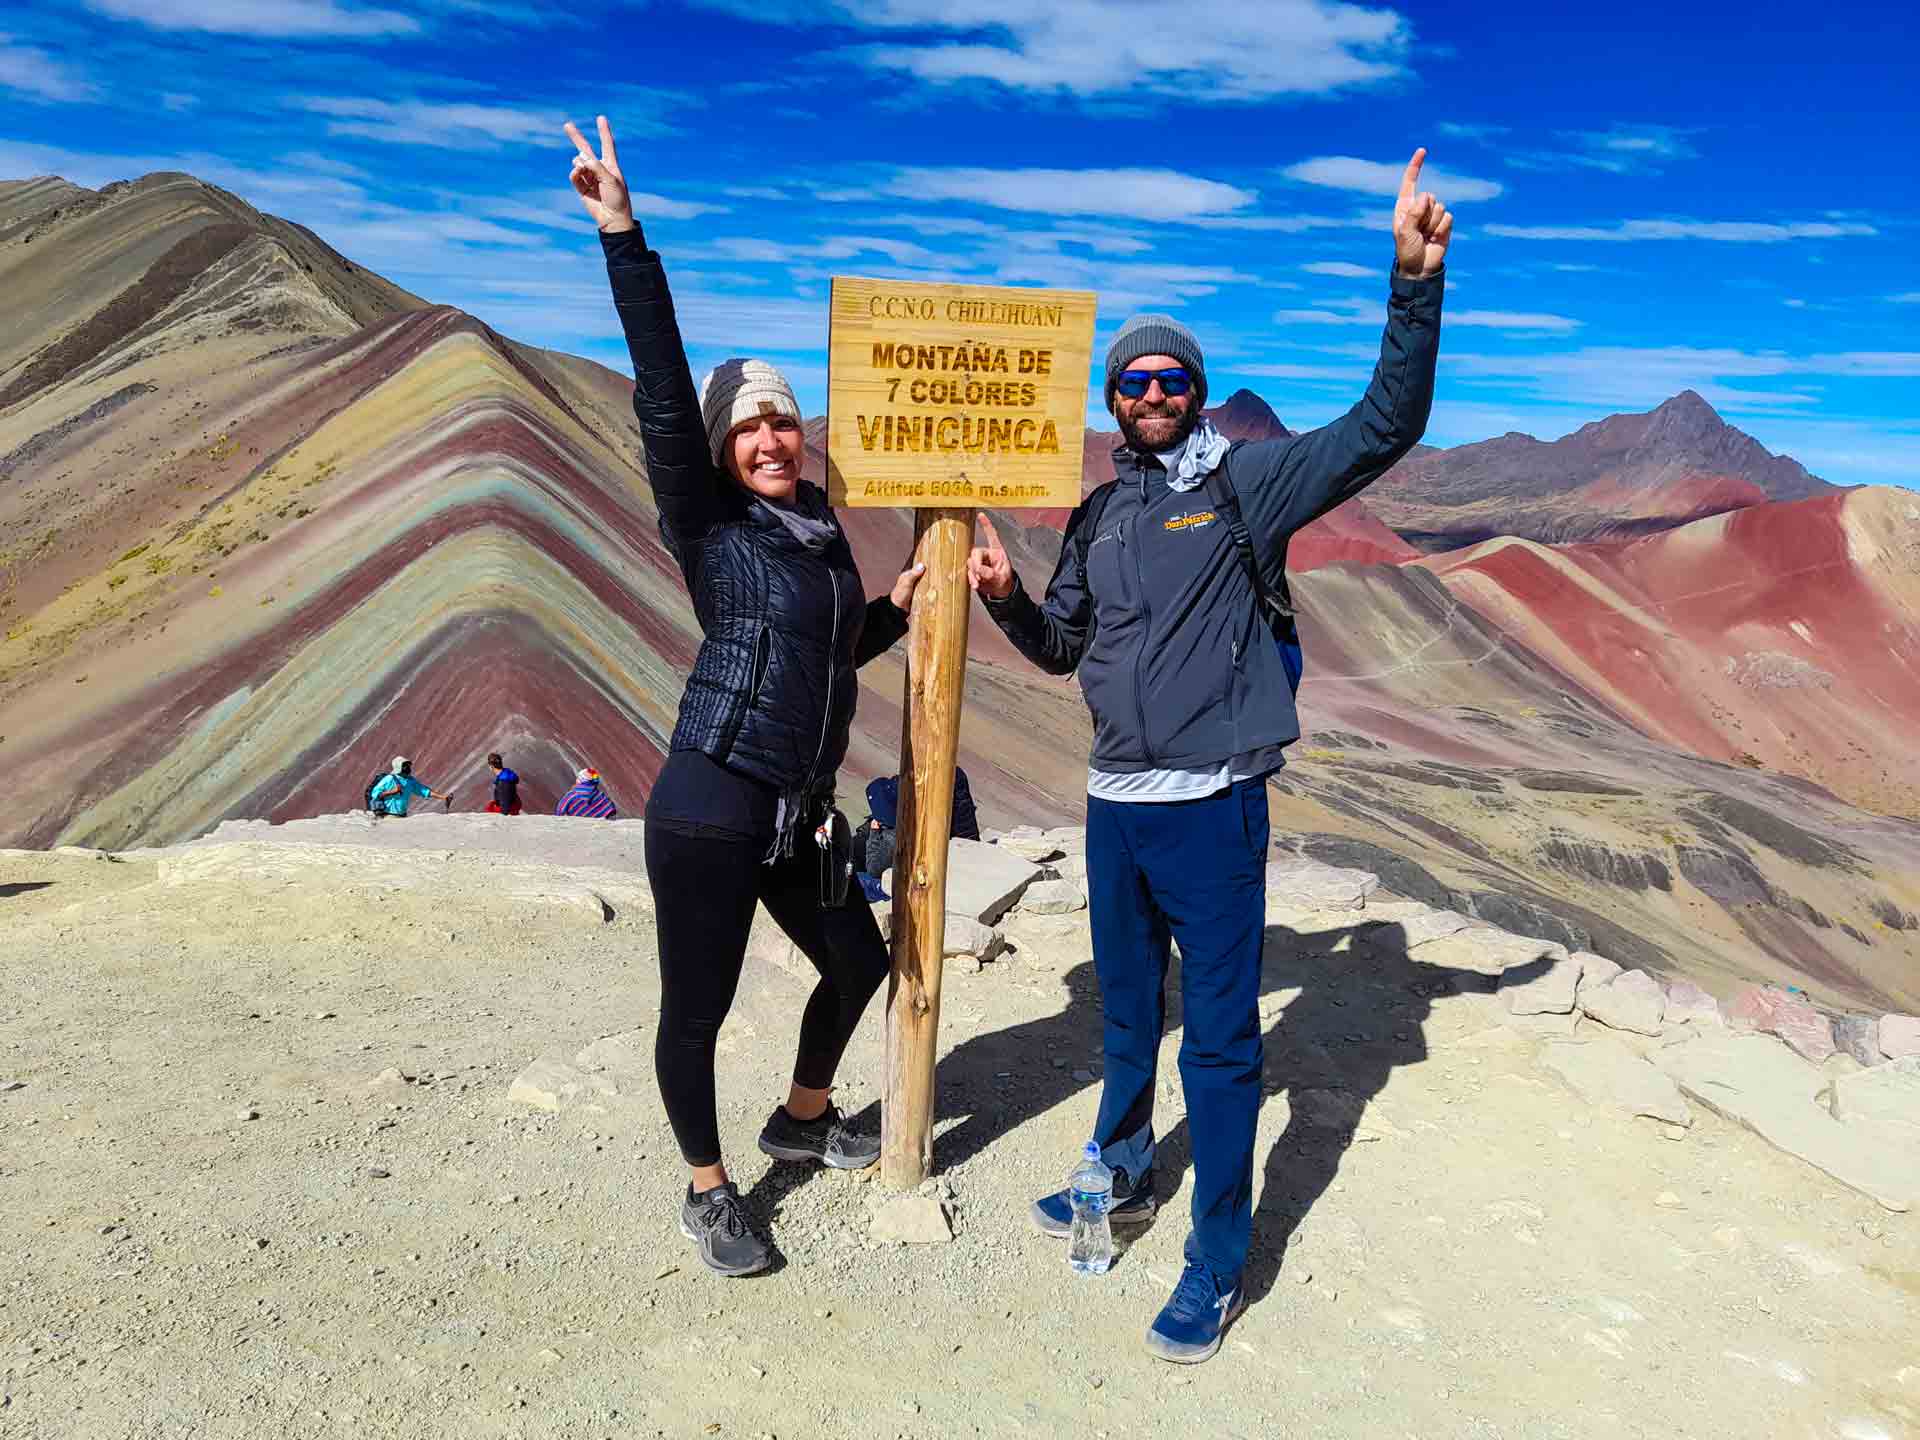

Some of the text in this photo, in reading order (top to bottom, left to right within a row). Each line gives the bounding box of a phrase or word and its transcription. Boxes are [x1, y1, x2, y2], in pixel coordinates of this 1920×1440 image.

[870, 296, 1063, 327] C.C.N.O. CHILLIHUANI
[872, 343, 1053, 374] MONTAÑA DE
[886, 378, 1037, 407] 7 COLORES
[856, 415, 1060, 454] VINICUNCA
[864, 480, 925, 497] Altitud
[978, 485, 1050, 497] m.s.n.m.
